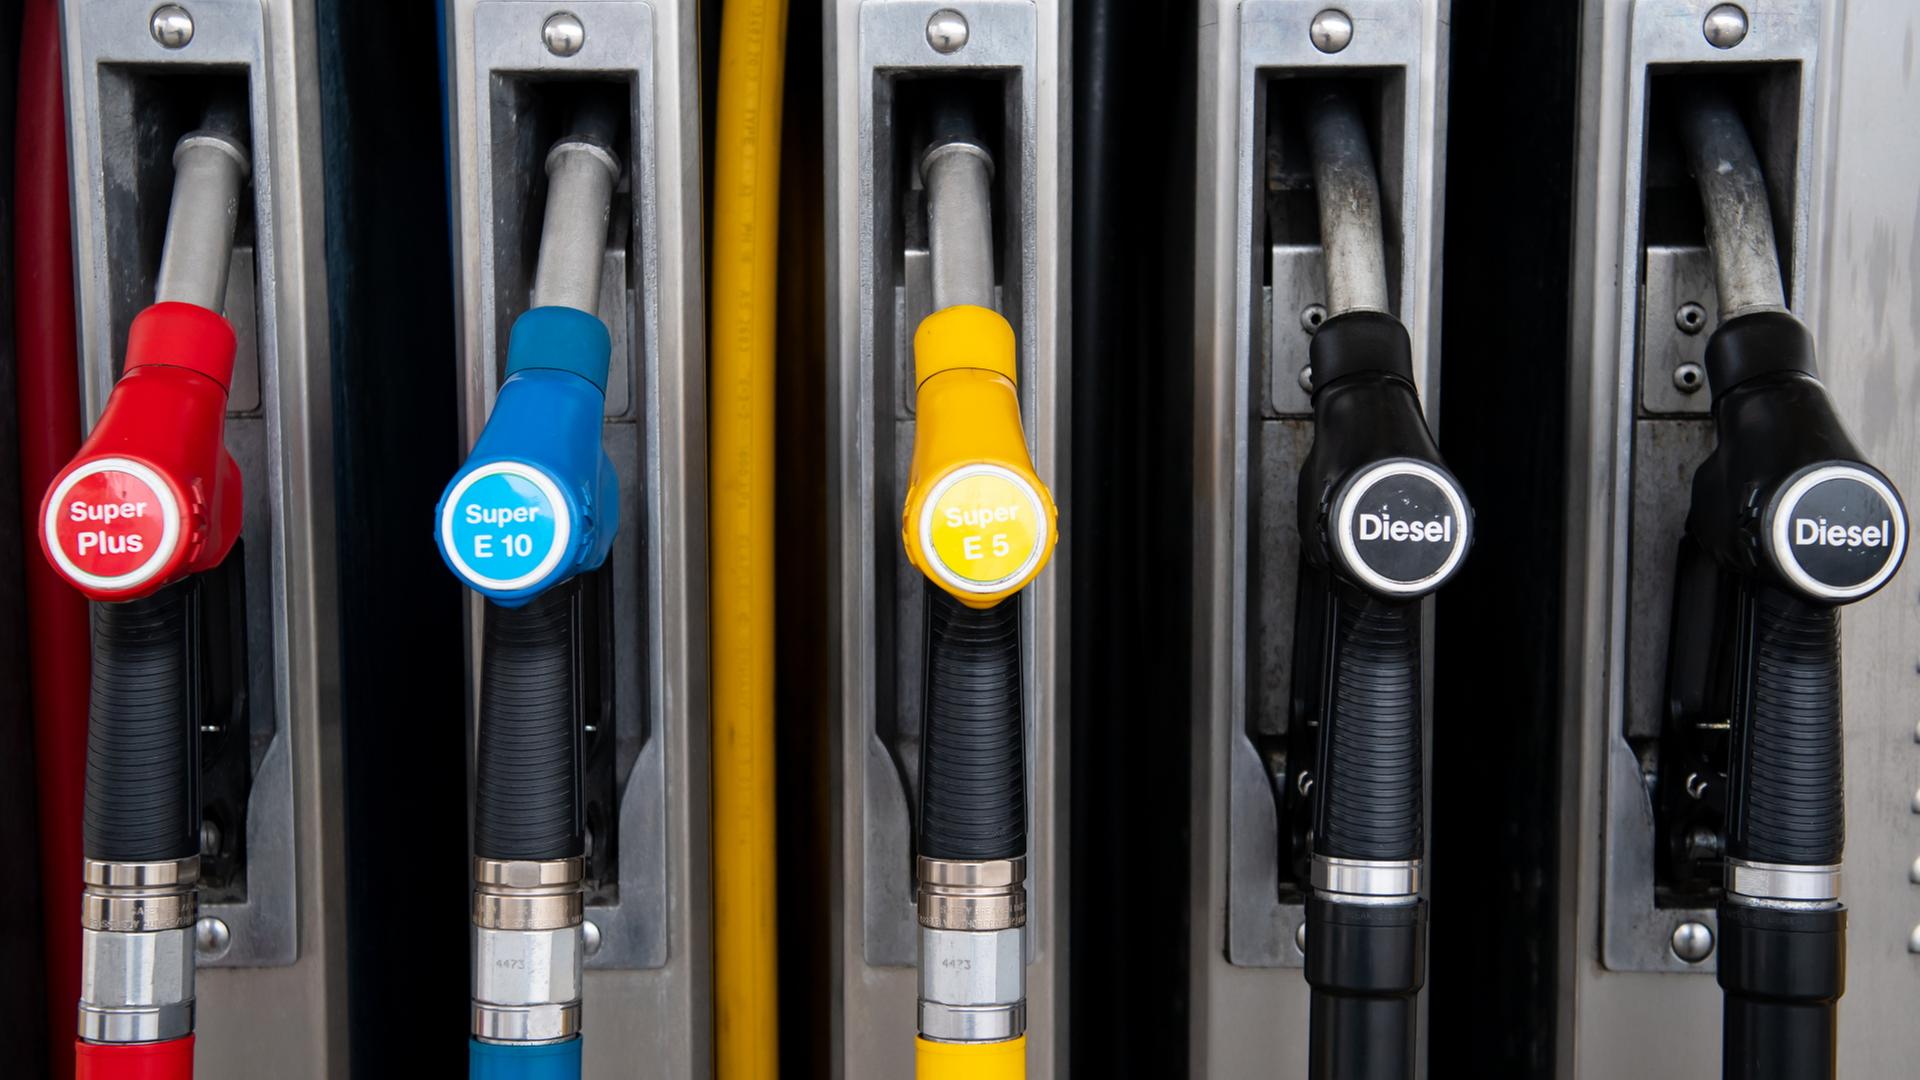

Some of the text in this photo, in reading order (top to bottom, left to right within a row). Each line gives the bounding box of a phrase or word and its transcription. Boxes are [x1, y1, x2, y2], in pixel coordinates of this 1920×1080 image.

[70, 501, 147, 524] Super
[466, 503, 540, 528] Super
[945, 505, 1018, 529] Super
[1360, 513, 1450, 542] Diesel
[1796, 518, 1889, 547] Diesel
[78, 530, 143, 556] Plus
[474, 533, 532, 558] E 10
[963, 533, 1009, 560] E 5
[496, 959, 525, 970] 4473
[942, 958, 971, 970] 4473
